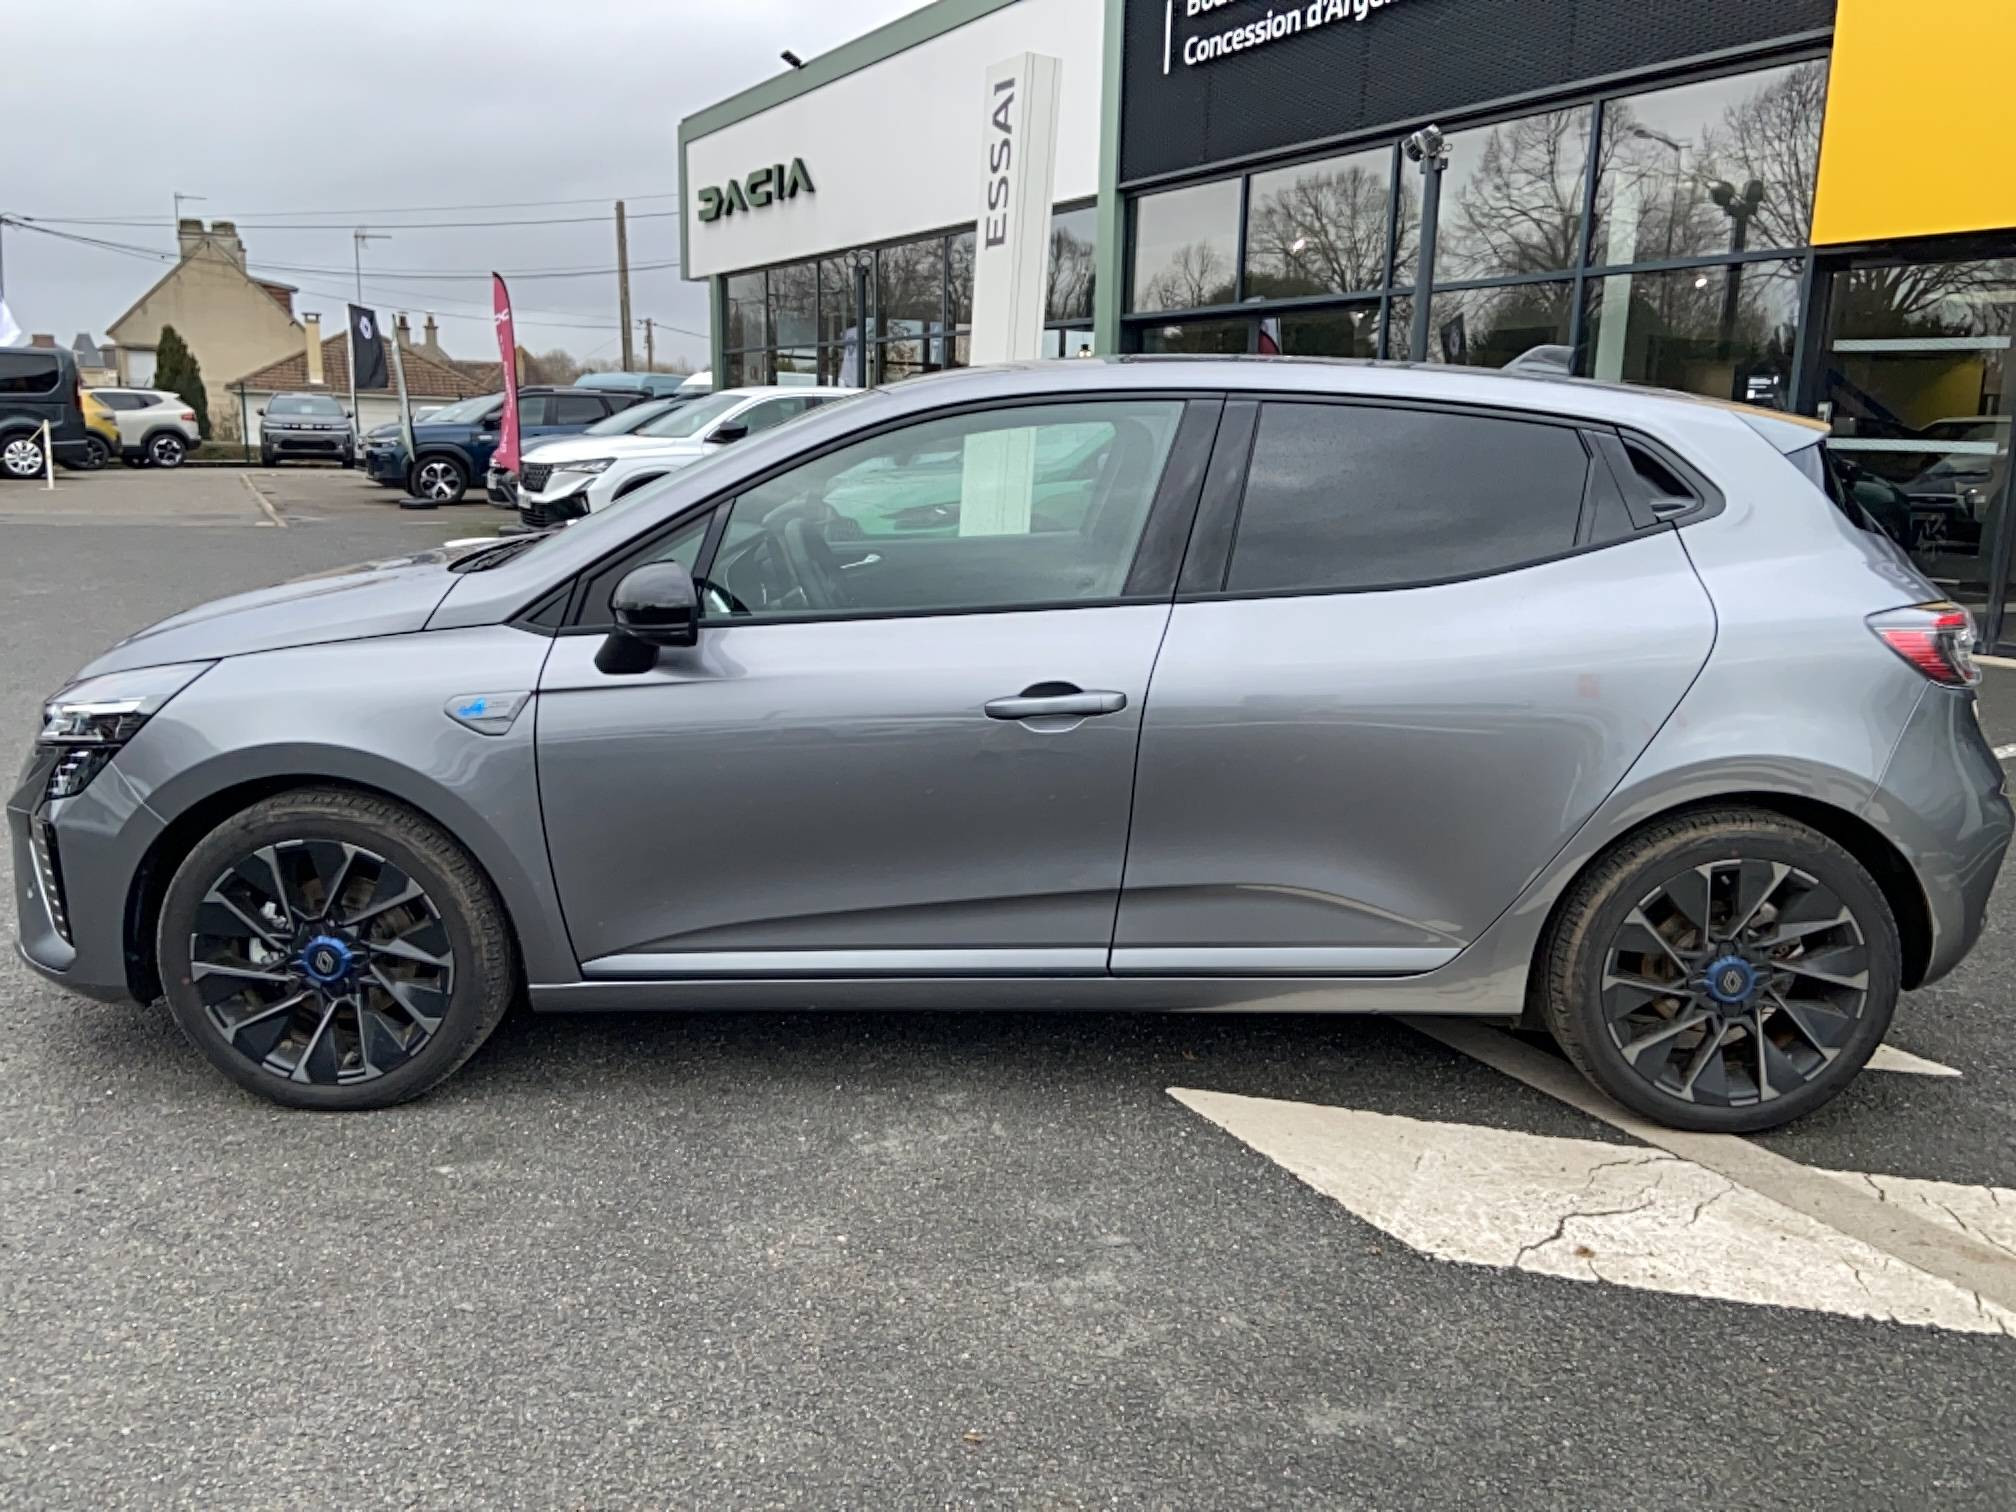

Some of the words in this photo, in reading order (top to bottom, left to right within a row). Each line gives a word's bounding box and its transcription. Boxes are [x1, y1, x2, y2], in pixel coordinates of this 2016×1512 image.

[1184, 9, 1301, 65] Concession
[698, 157, 815, 222] DACIA
[985, 77, 1016, 250] ESSAI
